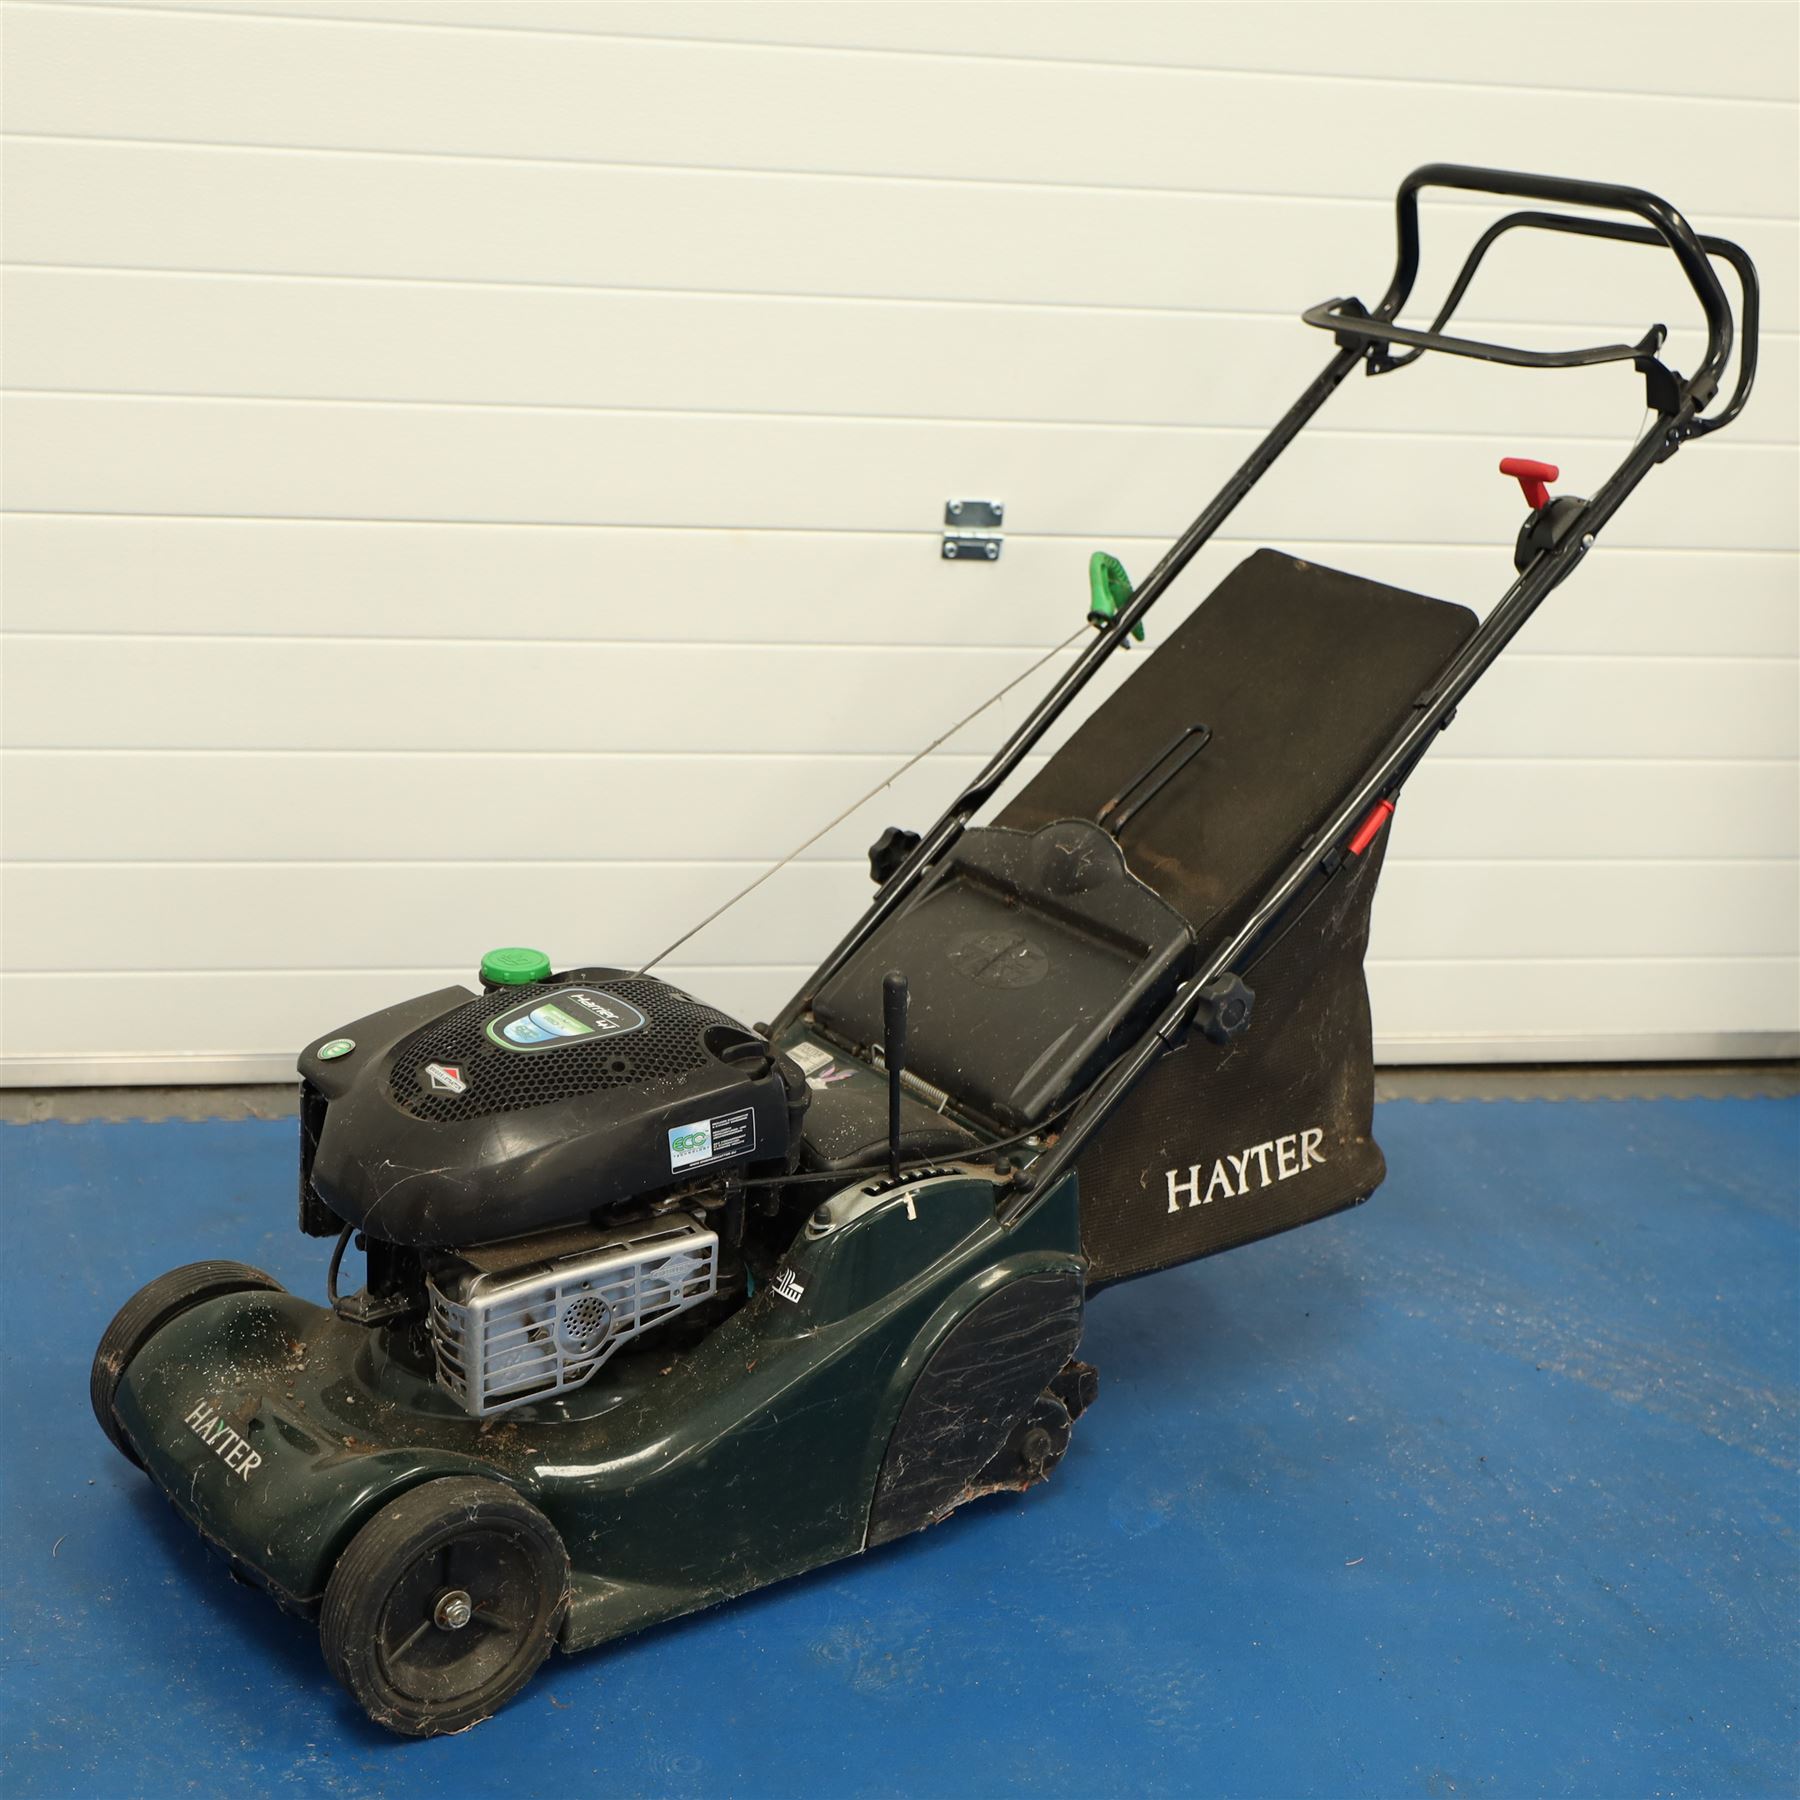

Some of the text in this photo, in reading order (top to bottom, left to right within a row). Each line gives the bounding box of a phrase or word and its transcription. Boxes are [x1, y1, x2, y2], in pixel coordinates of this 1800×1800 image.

[570, 993, 619, 1020] Harrier
[672, 1131, 707, 1152] ECO
[1165, 1127, 1327, 1213] HAYTER
[184, 1401, 262, 1482] HAYTER
